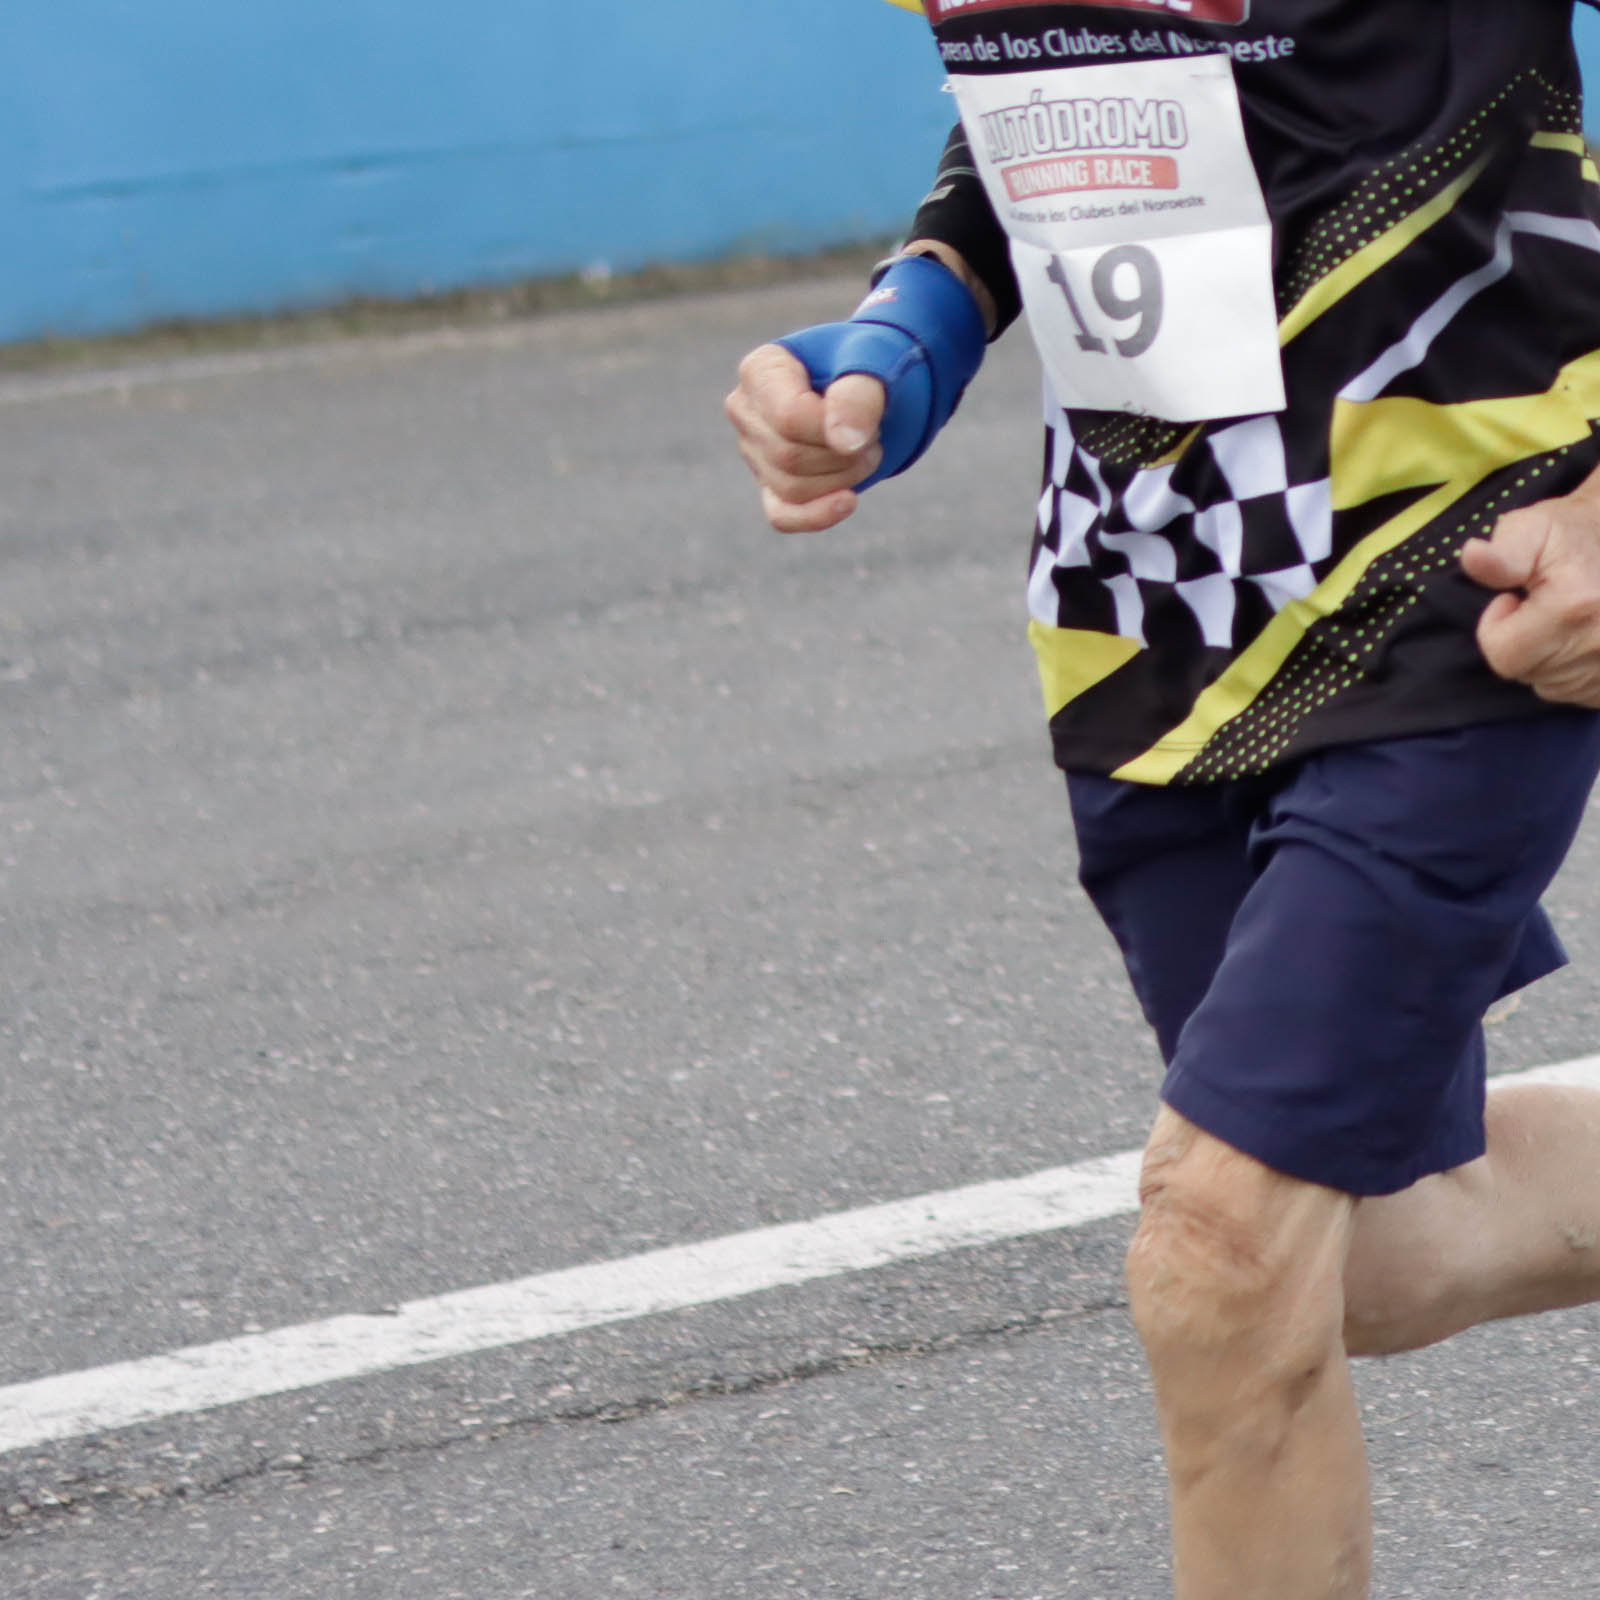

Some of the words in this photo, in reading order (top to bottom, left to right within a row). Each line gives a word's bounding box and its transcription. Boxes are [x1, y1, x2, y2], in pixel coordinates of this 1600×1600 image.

[972, 33, 1001, 62] de
[1001, 31, 1042, 60] los
[1042, 27, 1127, 58] Clubes
[979, 87, 1188, 164] AUTÓDROMO
[1008, 158, 1089, 197] RUNNING
[1093, 157, 1155, 187] RACE
[1045, 243, 1165, 359] 19
